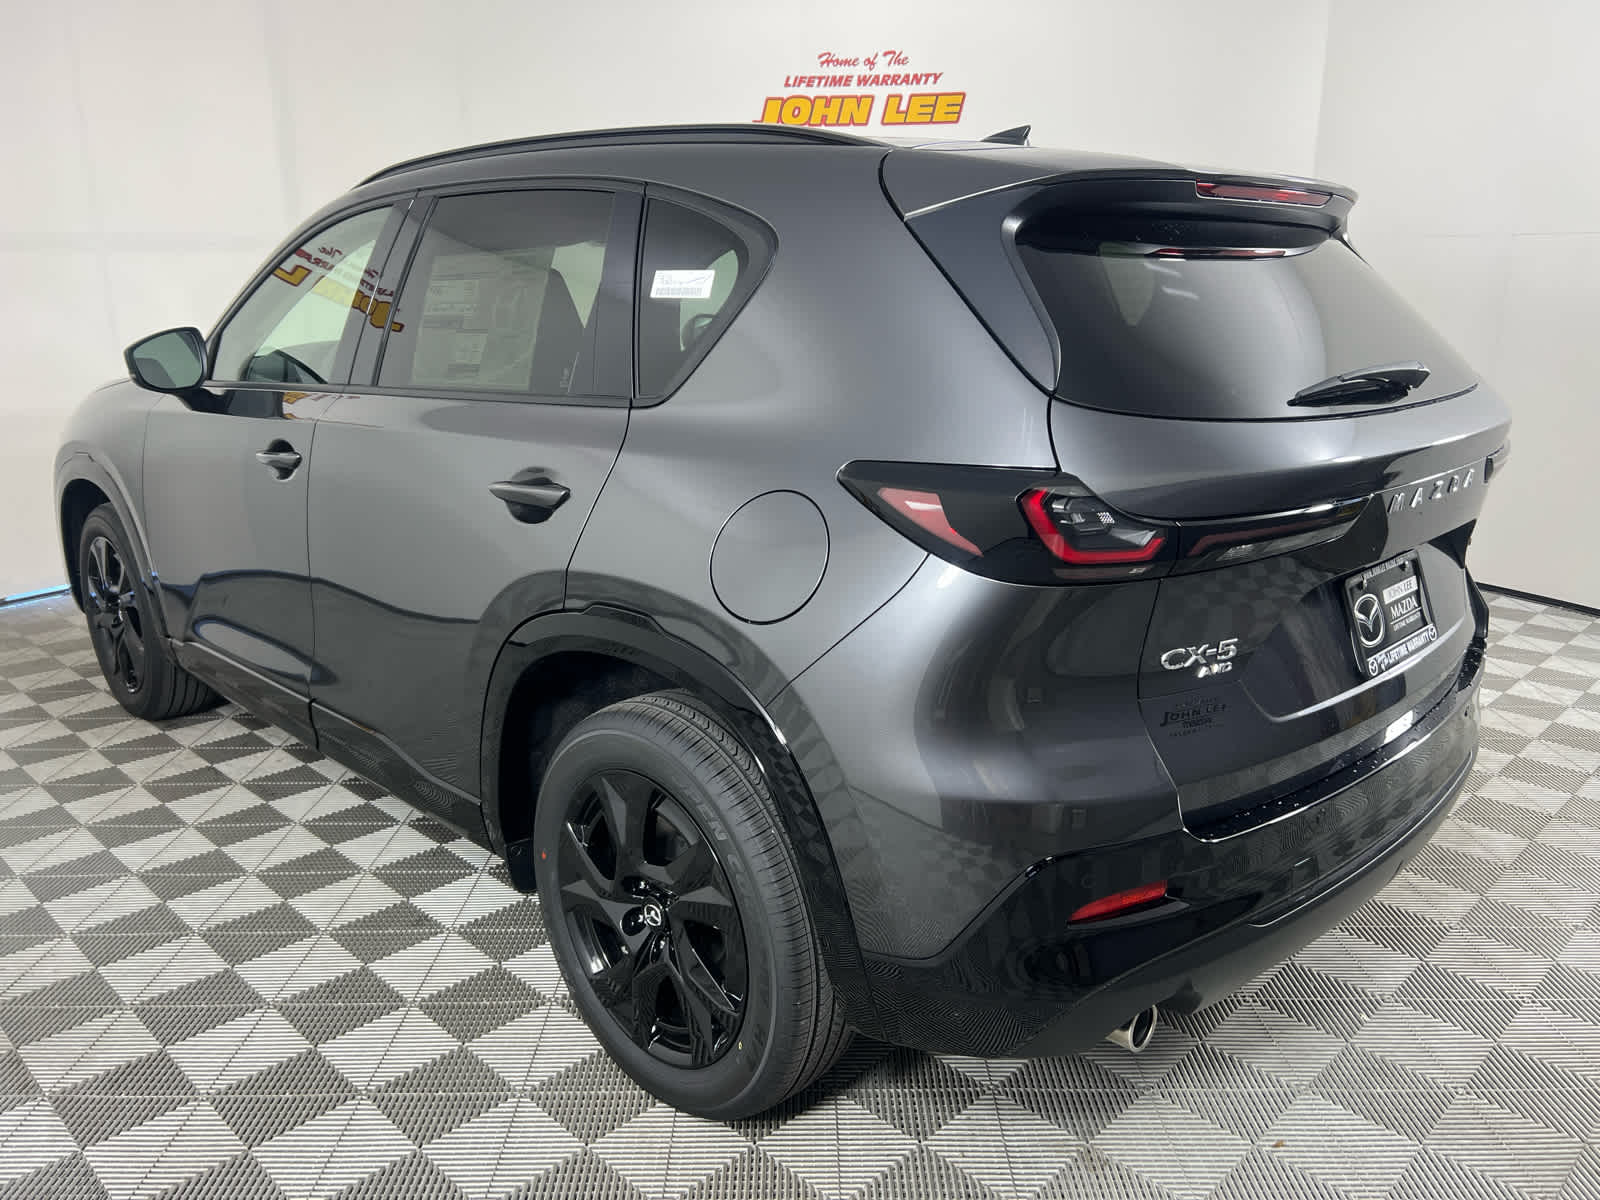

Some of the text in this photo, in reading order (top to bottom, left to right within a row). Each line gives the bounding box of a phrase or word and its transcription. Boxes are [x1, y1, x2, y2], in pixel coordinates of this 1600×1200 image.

[817, 50, 910, 71] Home of The
[783, 72, 944, 88] LIFETIME WARRANTY
[752, 91, 966, 127] JOHN LEE
[1386, 468, 1476, 514] MAZDA
[1390, 594, 1419, 619] MAZDA
[1161, 638, 1239, 670] CX-5
[1197, 661, 1233, 678] AWD
